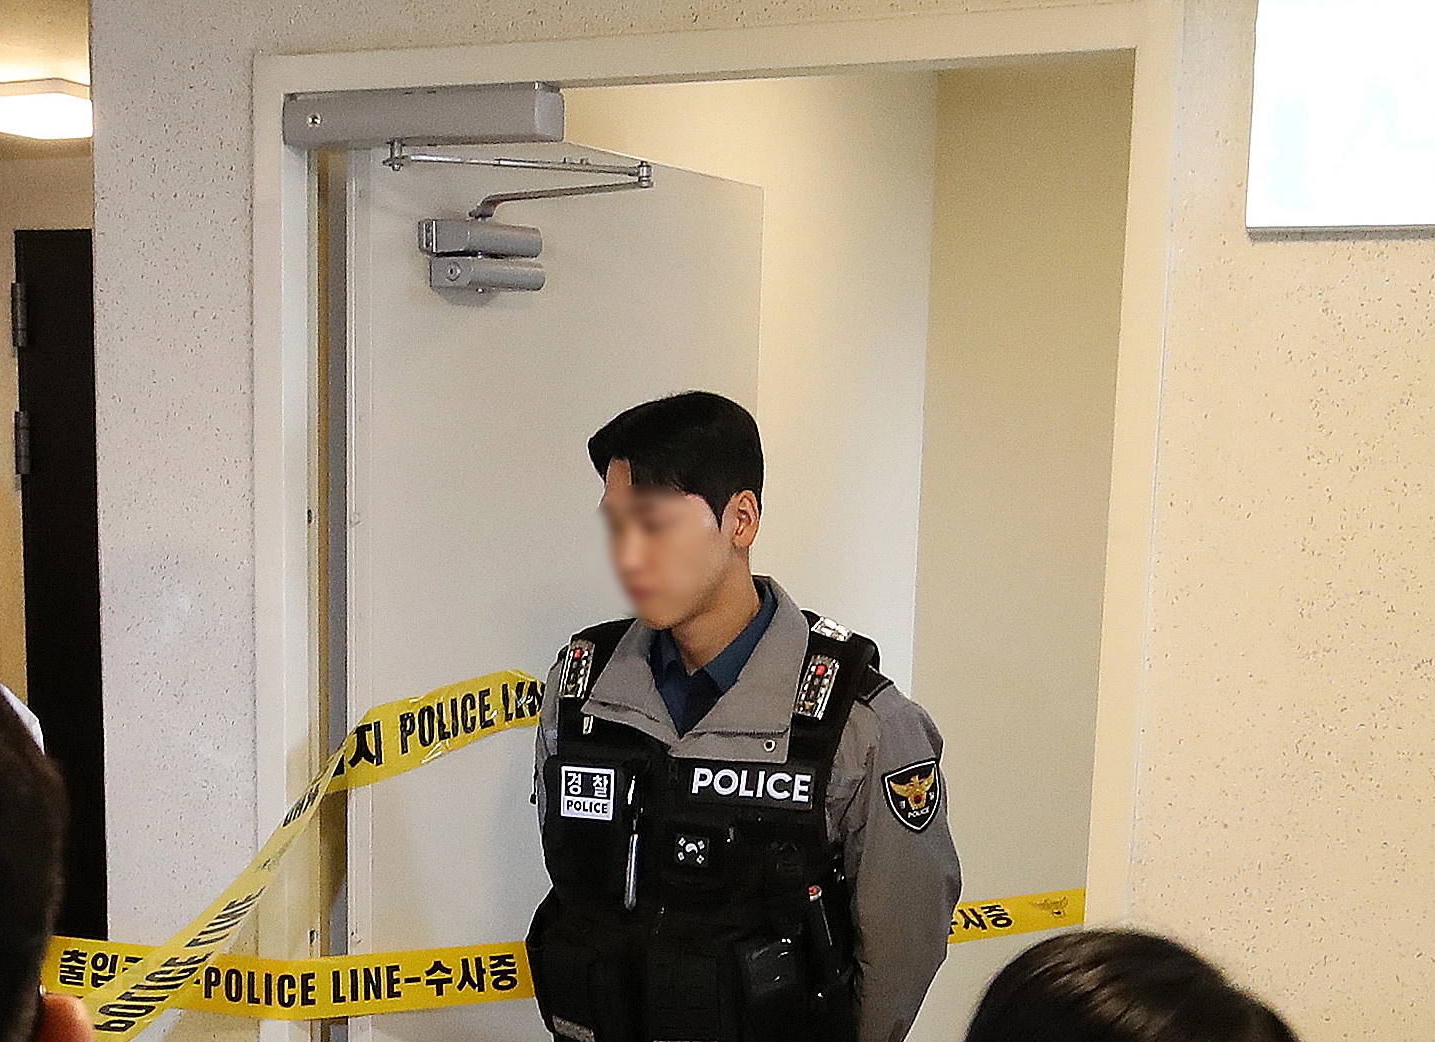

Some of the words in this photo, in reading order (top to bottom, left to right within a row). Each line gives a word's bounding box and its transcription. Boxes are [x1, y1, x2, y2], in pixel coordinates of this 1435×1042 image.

[399, 687, 495, 755] POLICE
[566, 801, 608, 814] POLICE
[691, 767, 812, 803] POLICE
[94, 951, 215, 1033] POLICE
